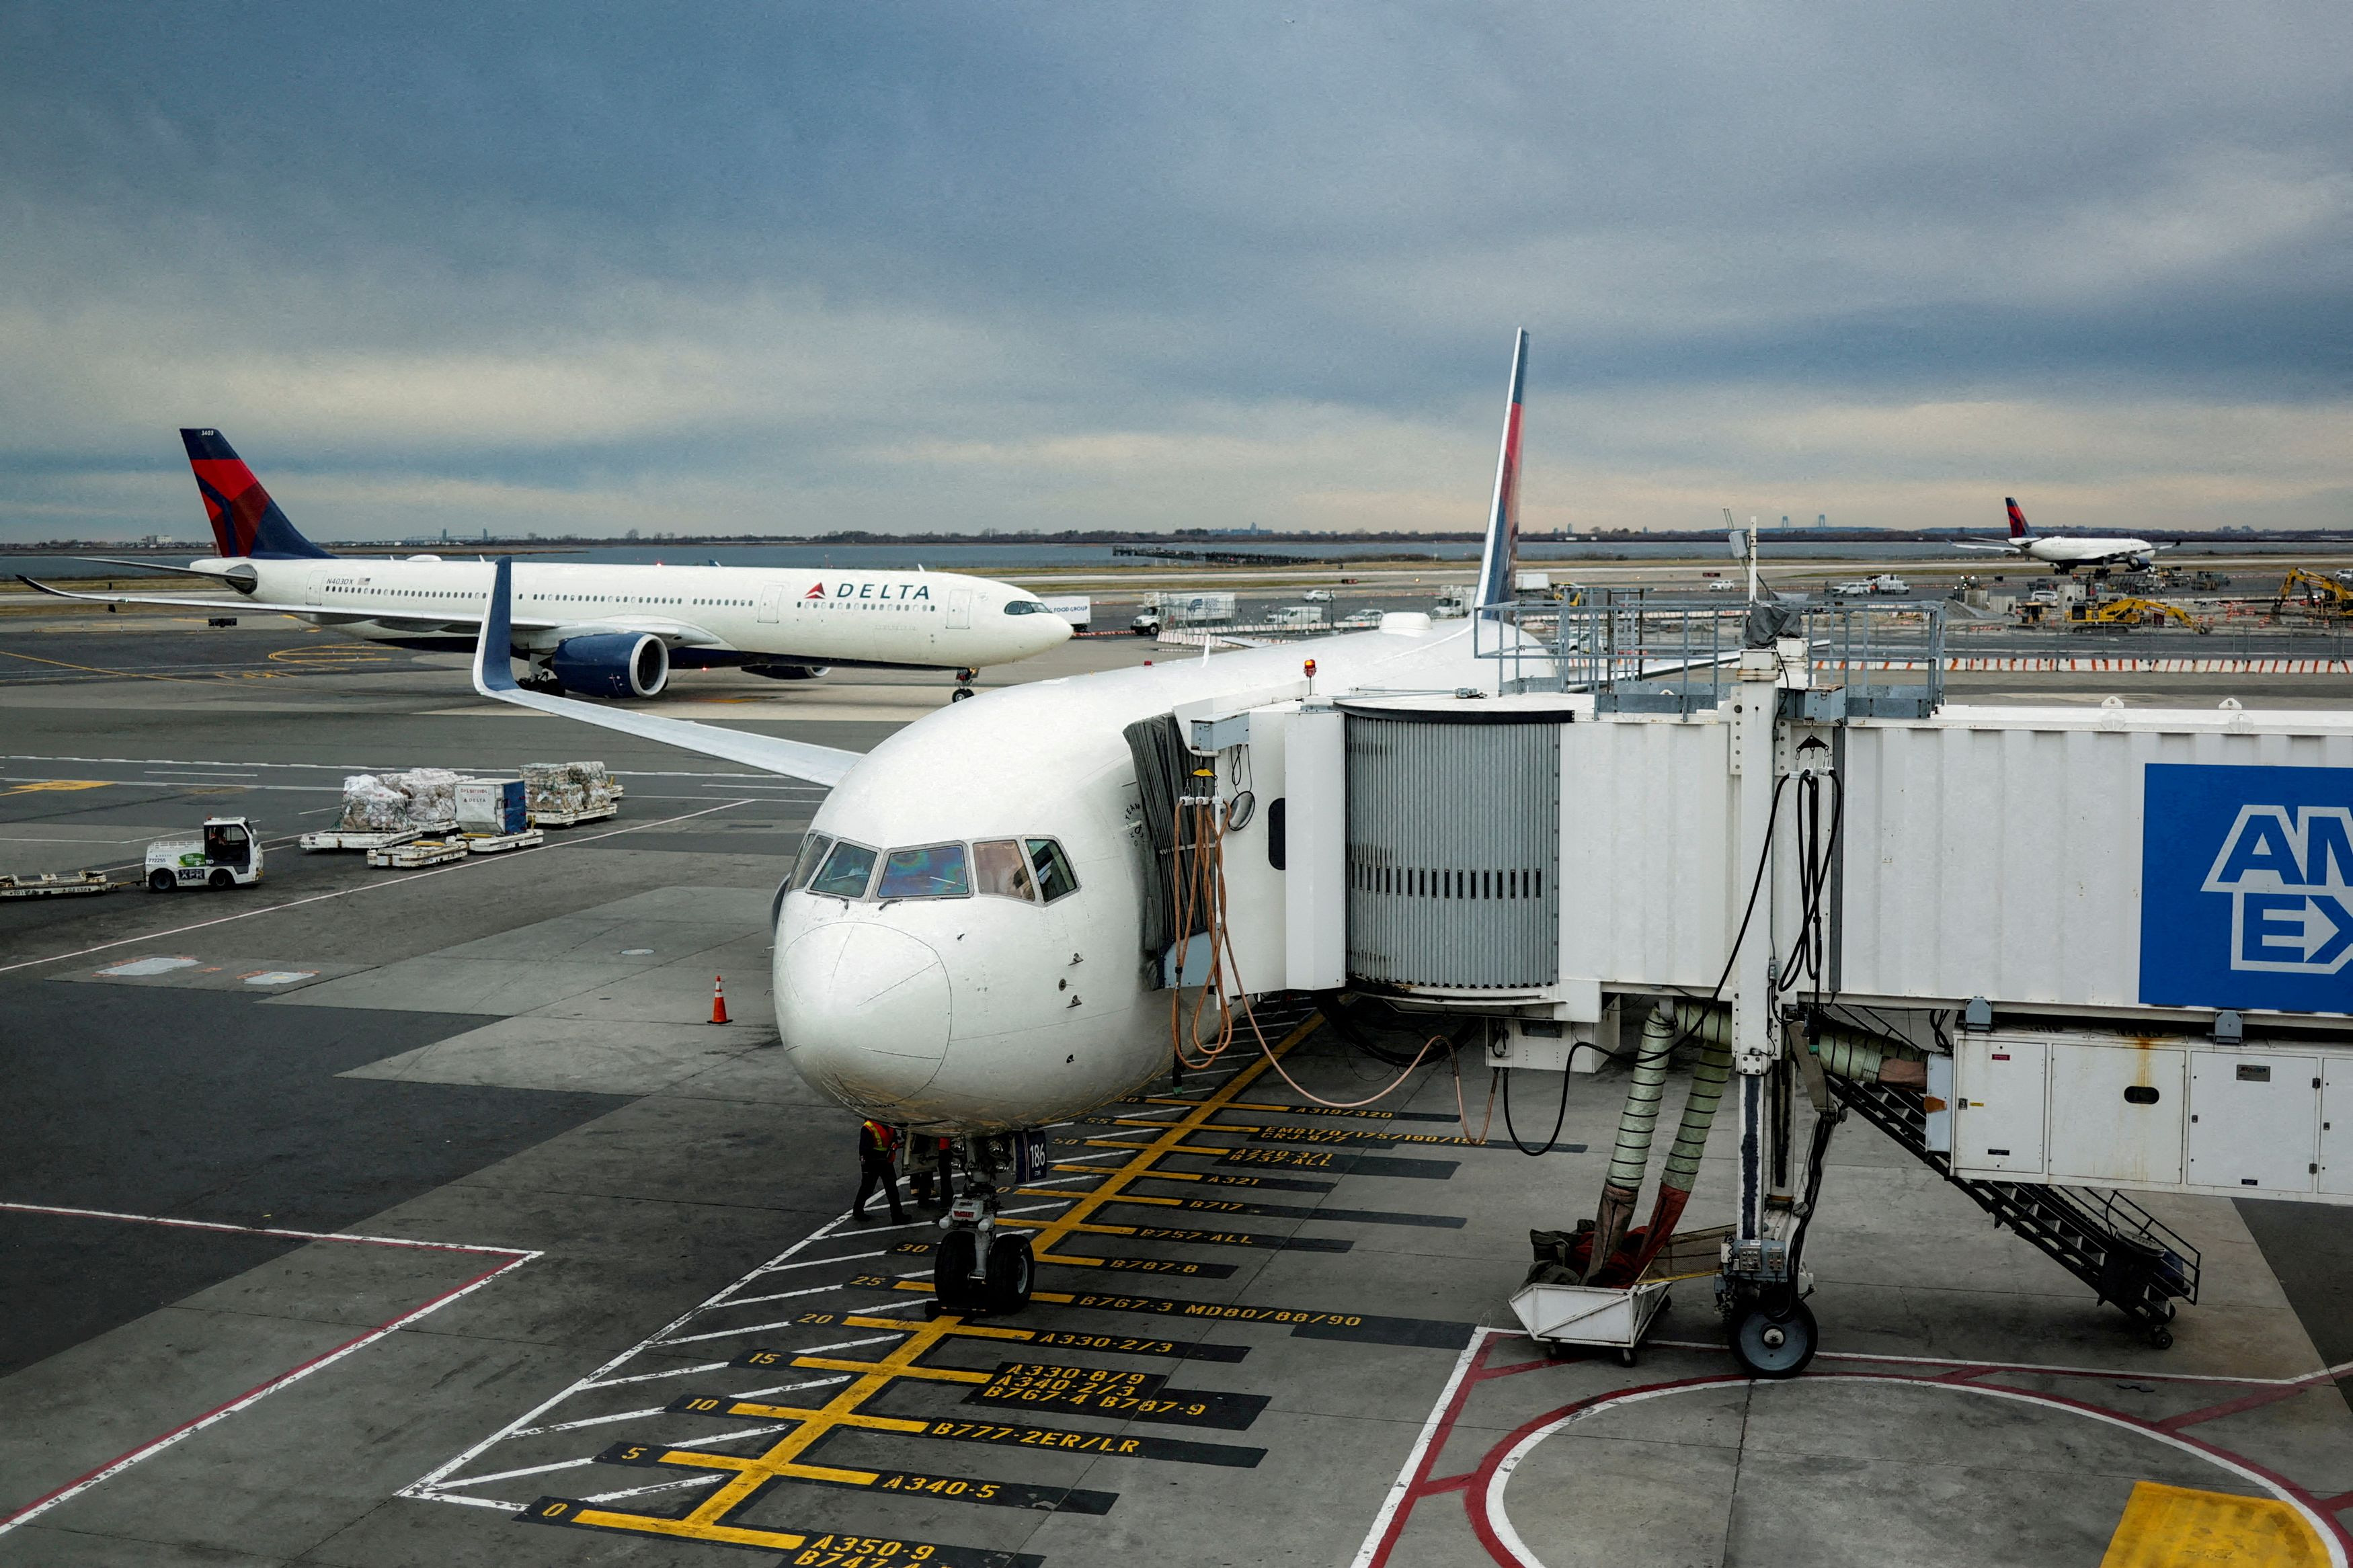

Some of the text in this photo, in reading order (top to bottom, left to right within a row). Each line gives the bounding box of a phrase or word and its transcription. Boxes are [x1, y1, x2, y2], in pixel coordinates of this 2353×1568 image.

[836, 583, 929, 600] DELTA
[180, 870, 204, 879] XFR
[1295, 1107, 1393, 1118] A319/320
[1030, 1143, 1045, 1168] 186
[1229, 1154, 1331, 1167] B737-ALL
[1208, 1176, 1261, 1186] A321
[1189, 1200, 1244, 1210] B717
[1140, 1229, 1253, 1243] B757-ALL
[897, 1243, 929, 1253] 30
[1110, 1260, 1199, 1273] B787-8
[849, 1276, 886, 1286] 25
[797, 1313, 834, 1323] 20
[1079, 1296, 1361, 1327] B767-3 MD80/88/90
[1039, 1333, 1172, 1353] A330-2/3
[748, 1353, 781, 1364] 15
[1005, 1364, 1146, 1385] A330-8/9
[994, 1375, 1135, 1397] A340-2/3
[686, 1398, 719, 1411] 10
[983, 1386, 1206, 1415] B767-4 B787-9
[932, 1422, 1140, 1453] B777-2ER/LR
[621, 1447, 648, 1460] 5
[882, 1475, 1001, 1498] A340-5
[542, 1503, 568, 1517] 0
[810, 1534, 935, 1560] A350-9
